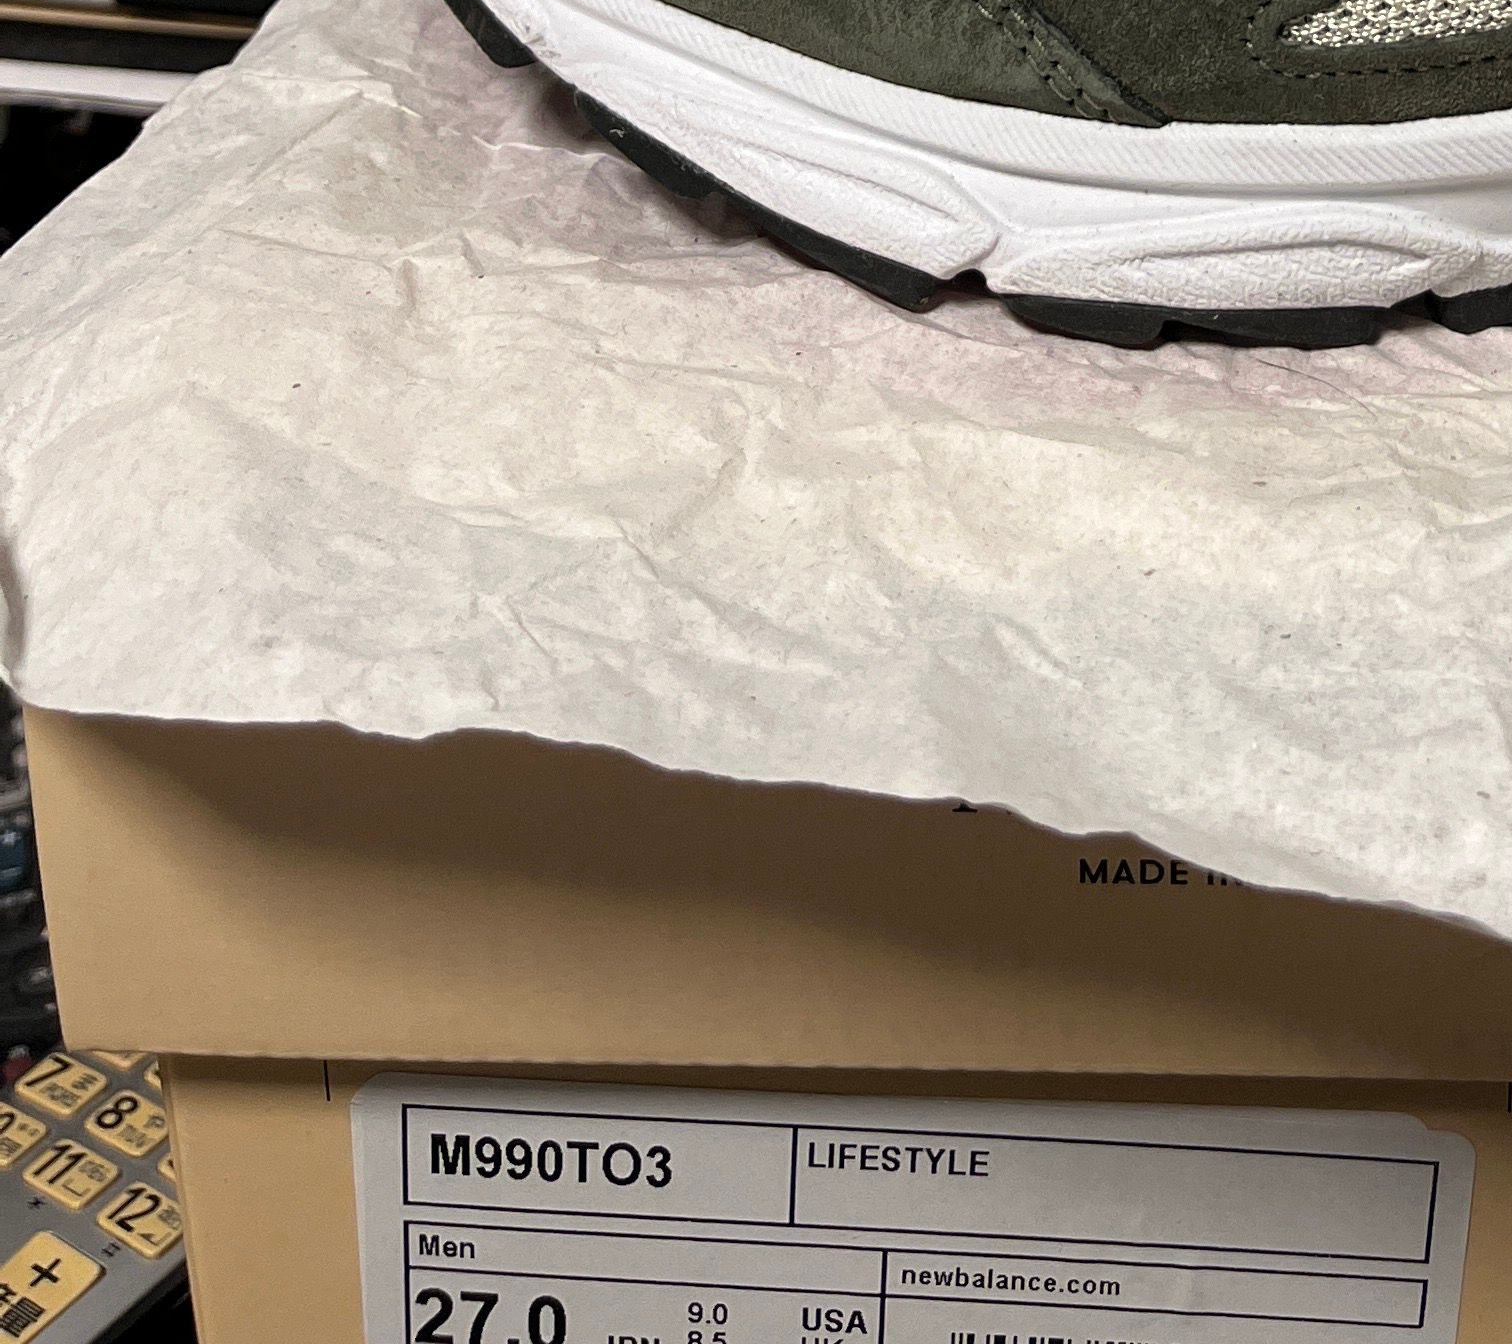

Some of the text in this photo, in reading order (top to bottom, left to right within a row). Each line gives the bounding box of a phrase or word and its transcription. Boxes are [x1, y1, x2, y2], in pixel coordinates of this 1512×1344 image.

[1079, 858, 1189, 885] MADE
[24, 1054, 71, 1087] 7
[96, 1096, 138, 1129] 8
[33, 1144, 87, 1185] 11
[429, 1133, 674, 1189] M990TO3
[807, 1141, 991, 1177] LIFESTYLE
[107, 1187, 161, 1232] 12
[418, 1233, 476, 1259] Men
[901, 1267, 1121, 1297] newbalance.com
[414, 1287, 567, 1344] 27.0
[687, 1302, 728, 1325] 9.0
[801, 1307, 868, 1334] USA
